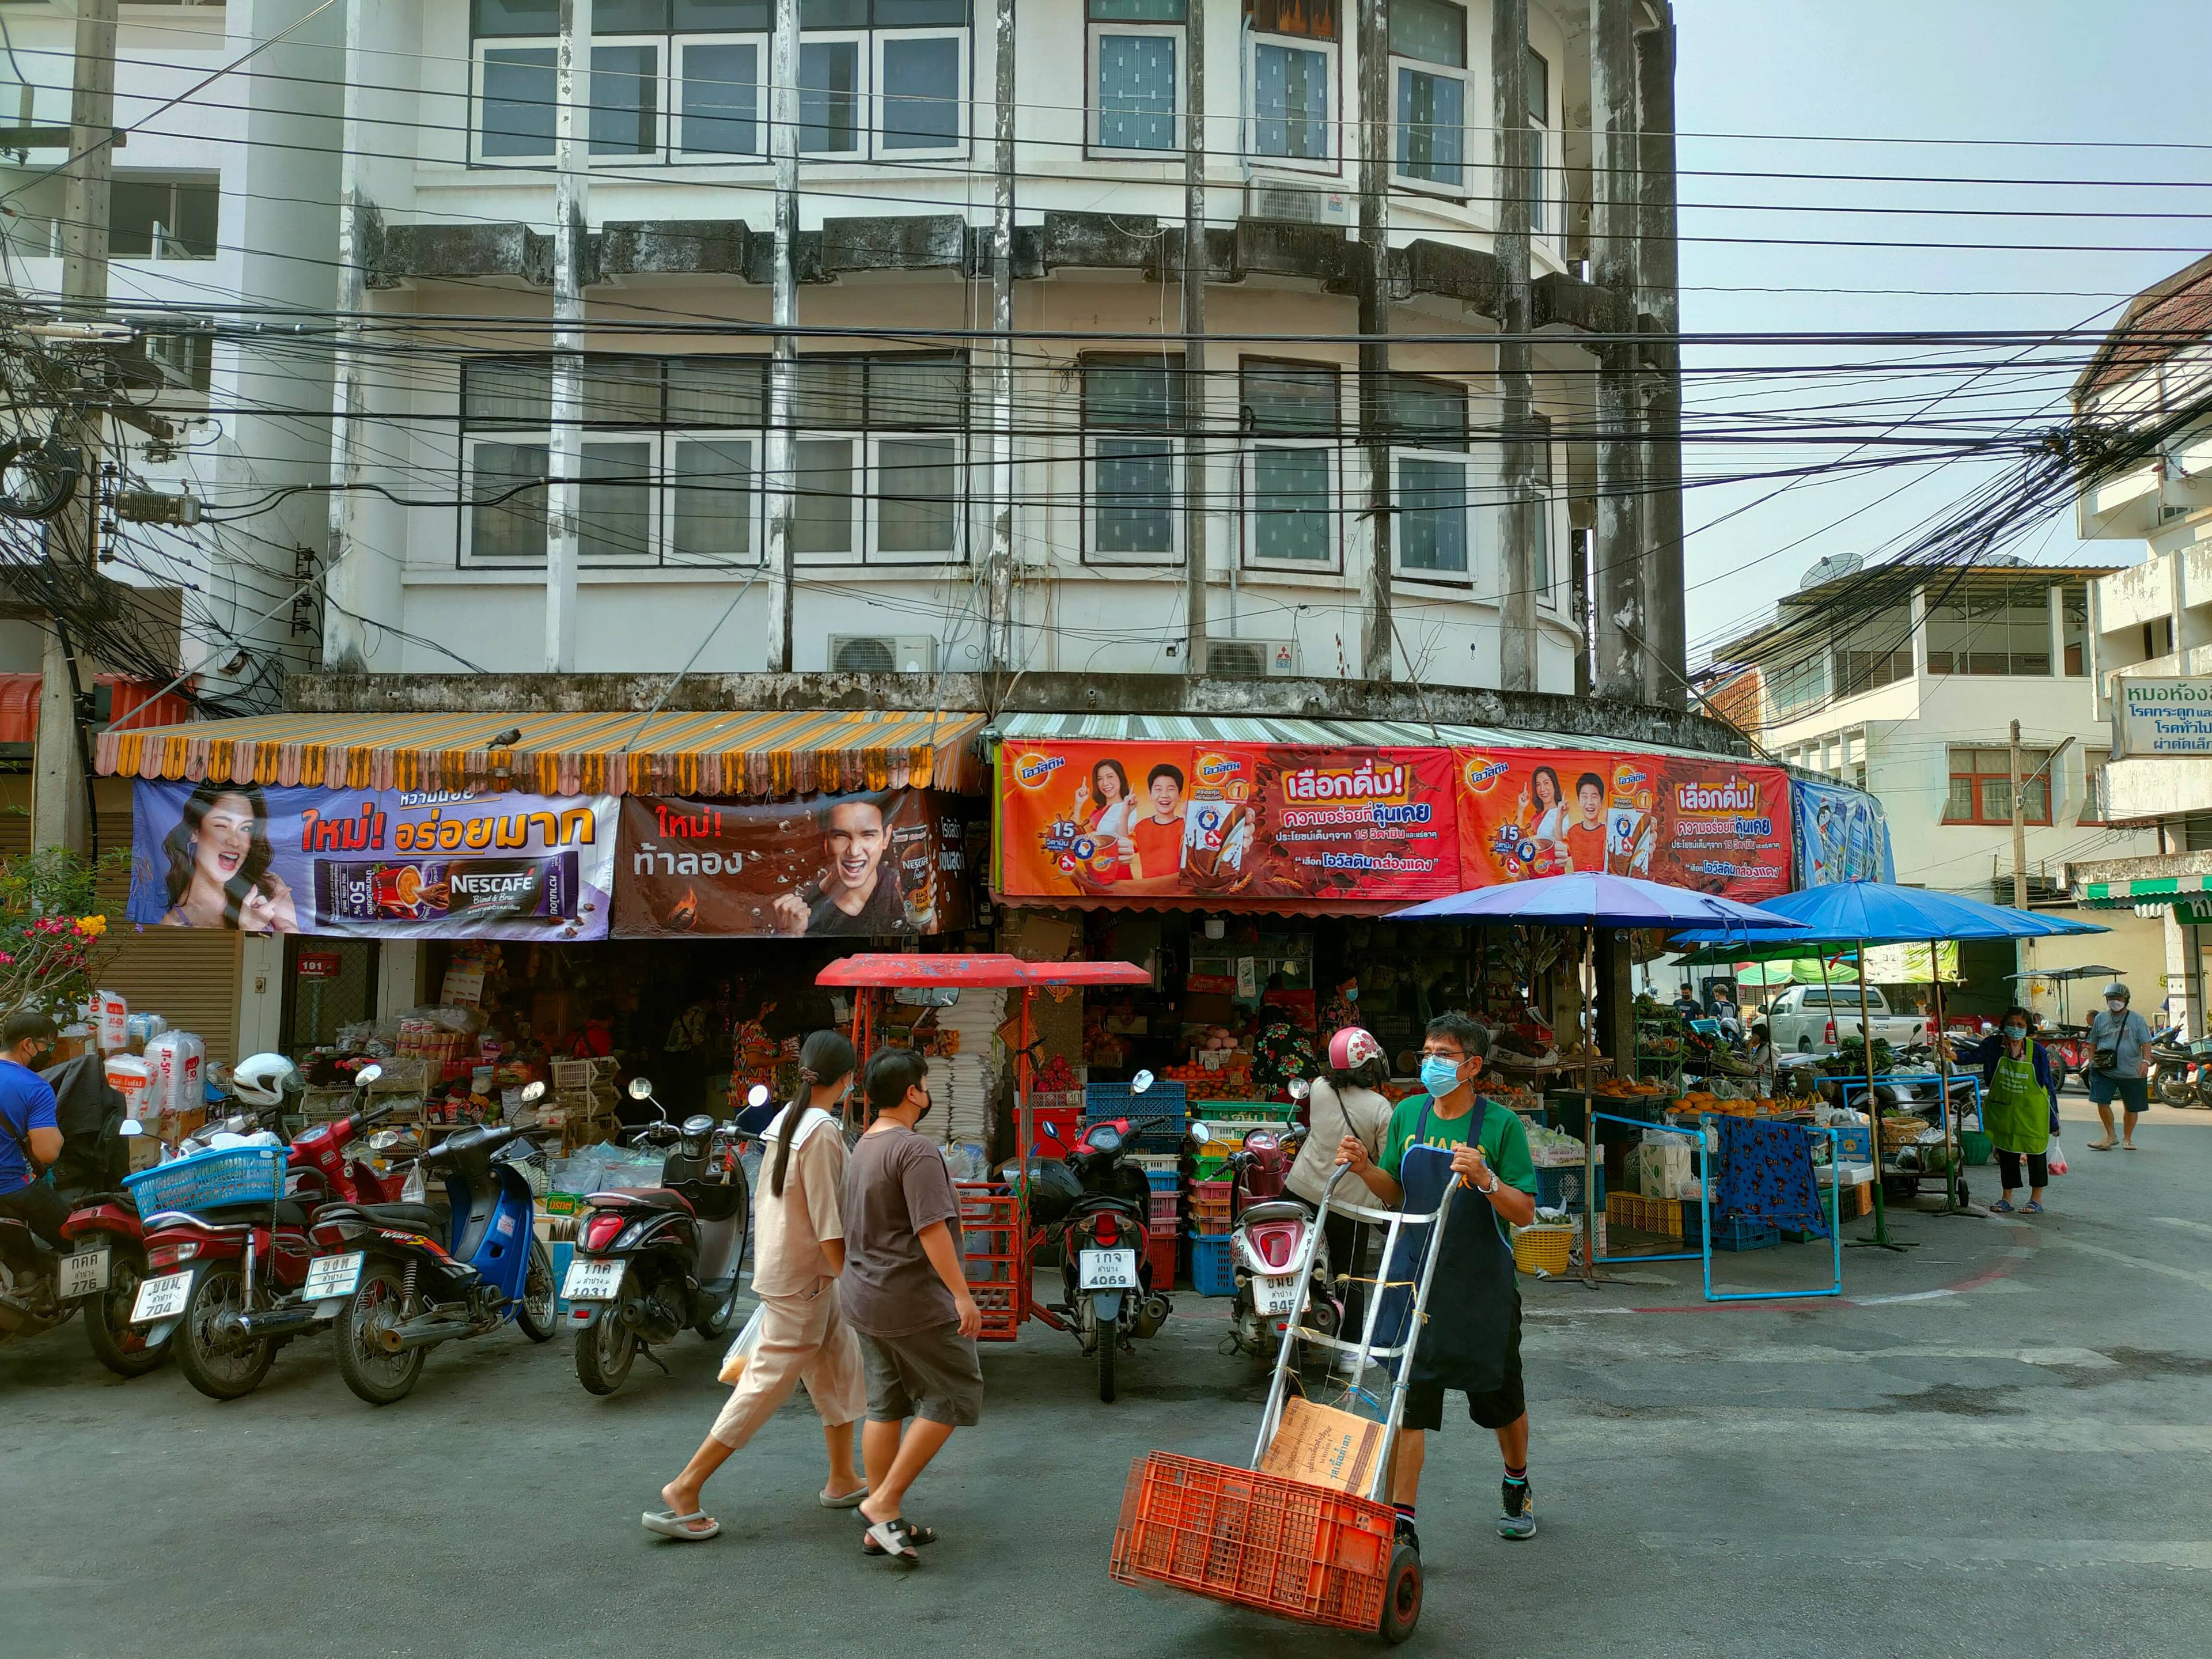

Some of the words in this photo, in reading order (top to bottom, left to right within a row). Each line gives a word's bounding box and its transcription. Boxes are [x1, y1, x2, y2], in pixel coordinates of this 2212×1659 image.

[2129, 703, 2194, 721] โรคกระดูก
[1021, 755, 1066, 780] โอวัลติน
[1203, 761, 1241, 776] โอวัลติน
[1471, 762, 1509, 783] โอวัลติน
[1287, 759, 1404, 799] เลือกดื่ม!
[1618, 772, 1647, 785] โอวัลติน
[1679, 775, 1755, 810] เลือกดื่ม!
[655, 805, 722, 838] ใหม่!
[1283, 801, 1431, 828] ความอร่อยที่คุ้นเคย
[301, 802, 387, 853] ใหม่!
[395, 808, 596, 850] อร่อยมาก
[1052, 822, 1075, 838] 15
[1499, 825, 1519, 840] 15
[1676, 815, 1771, 839] ความอร่อยที่คุ้นเคย
[1275, 830, 1352, 842] ประโยชน์เต็มๆจาก
[1354, 828, 1368, 840] 15
[1724, 839, 1733, 850] 15
[634, 842, 743, 875] ท้าลอง
[472, 895, 492, 905] Blend
[302, 961, 322, 970] 191
[380, 1230, 414, 1240] Wave
[74, 1270, 94, 1279] ลำปาง
[322, 1273, 343, 1283] ลำปาง
[583, 1276, 604, 1285] ลำปาง
[1090, 1275, 1127, 1285] 4069
[71, 1278, 97, 1294] 776
[325, 1283, 334, 1294] 4
[572, 1286, 608, 1297] 1031
[1272, 1290, 1292, 1298] ลำปาง
[146, 1302, 172, 1317] 704
[1302, 1414, 1310, 1431] CARE
